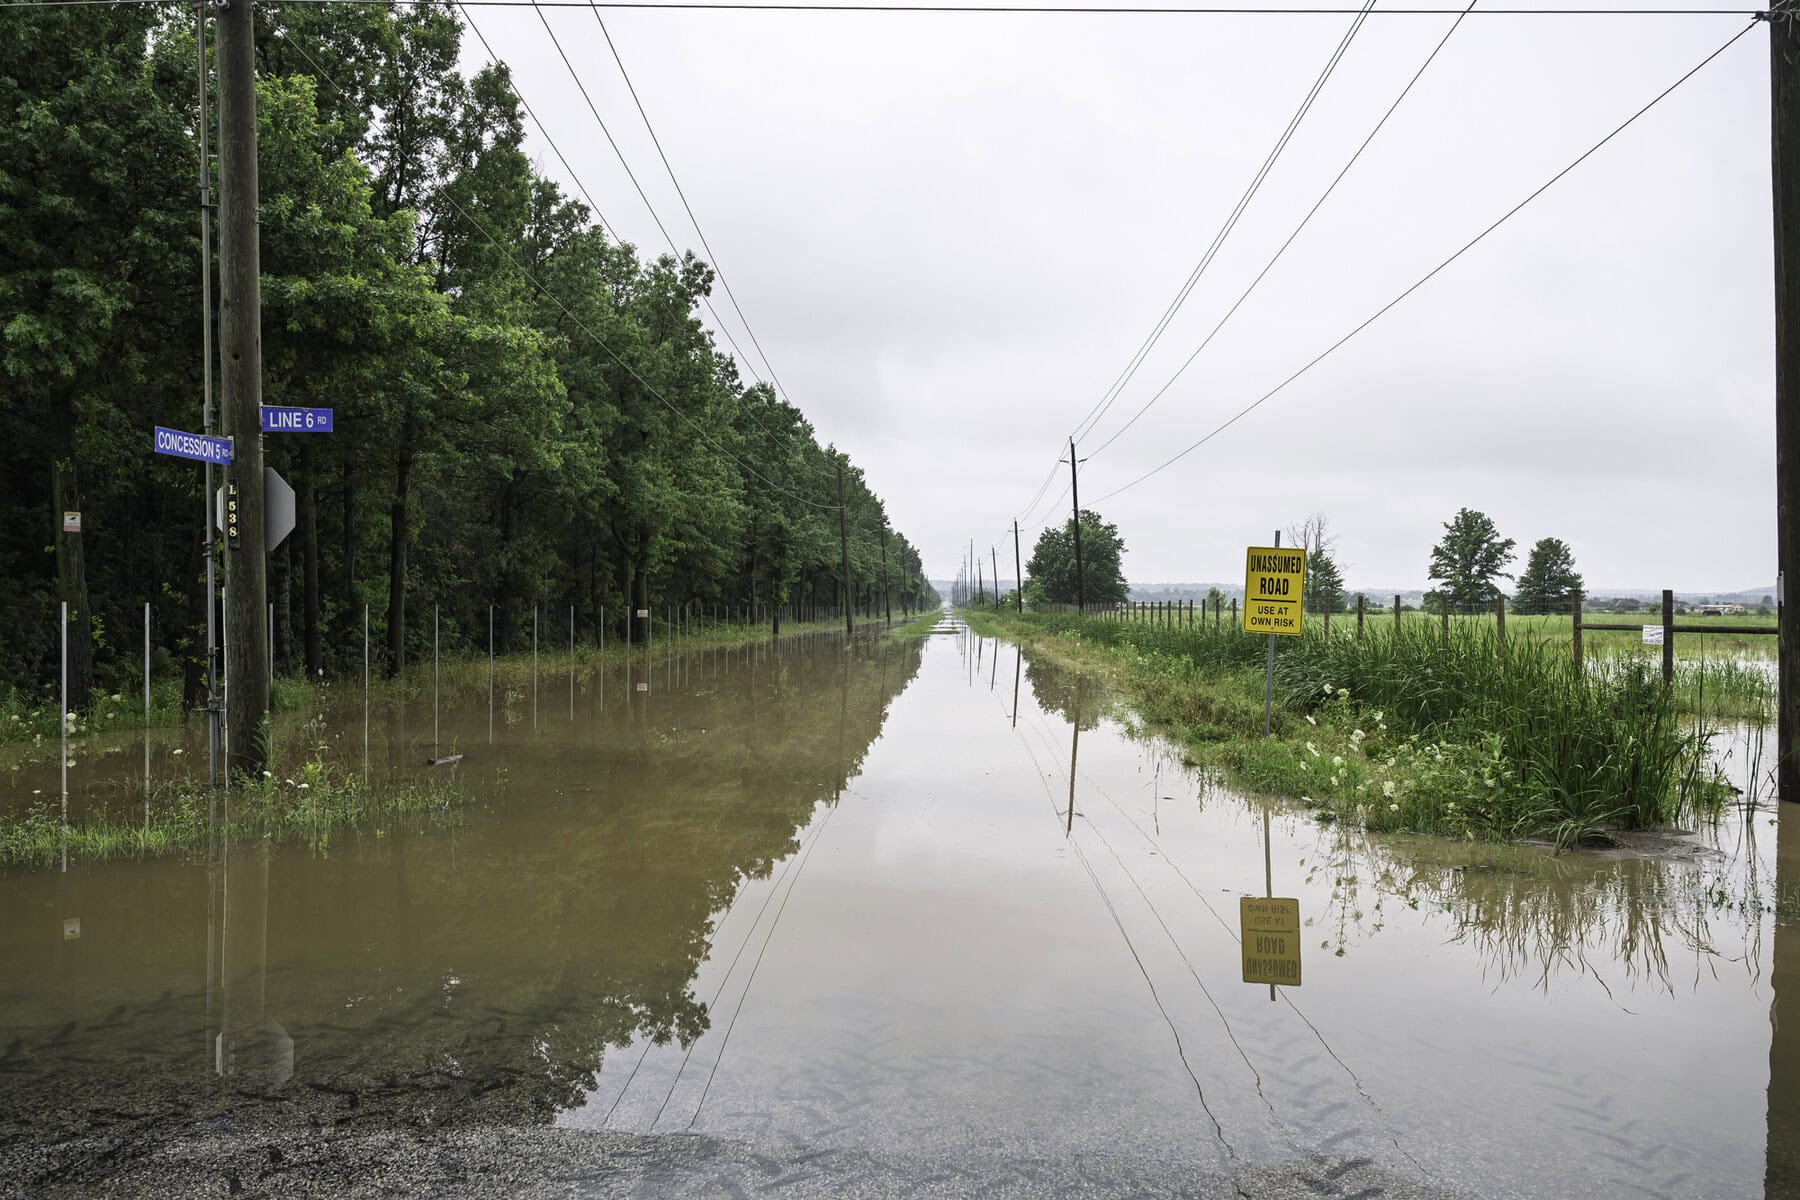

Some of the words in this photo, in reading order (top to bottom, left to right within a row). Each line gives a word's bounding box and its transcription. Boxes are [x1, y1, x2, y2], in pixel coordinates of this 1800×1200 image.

[269, 412, 302, 428] LINE
[305, 412, 314, 428] 6
[317, 416, 327, 425] RD
[158, 431, 214, 458] CONCESSION
[215, 444, 221, 459] 5
[228, 484, 236, 495] L
[1251, 555, 1301, 573] UNASSUMED
[1260, 577, 1289, 595] ROAD
[1258, 606, 1274, 614] USE
[1278, 607, 1288, 615] AT
[1251, 617, 1271, 626] OWN
[1274, 618, 1295, 628] RISK
